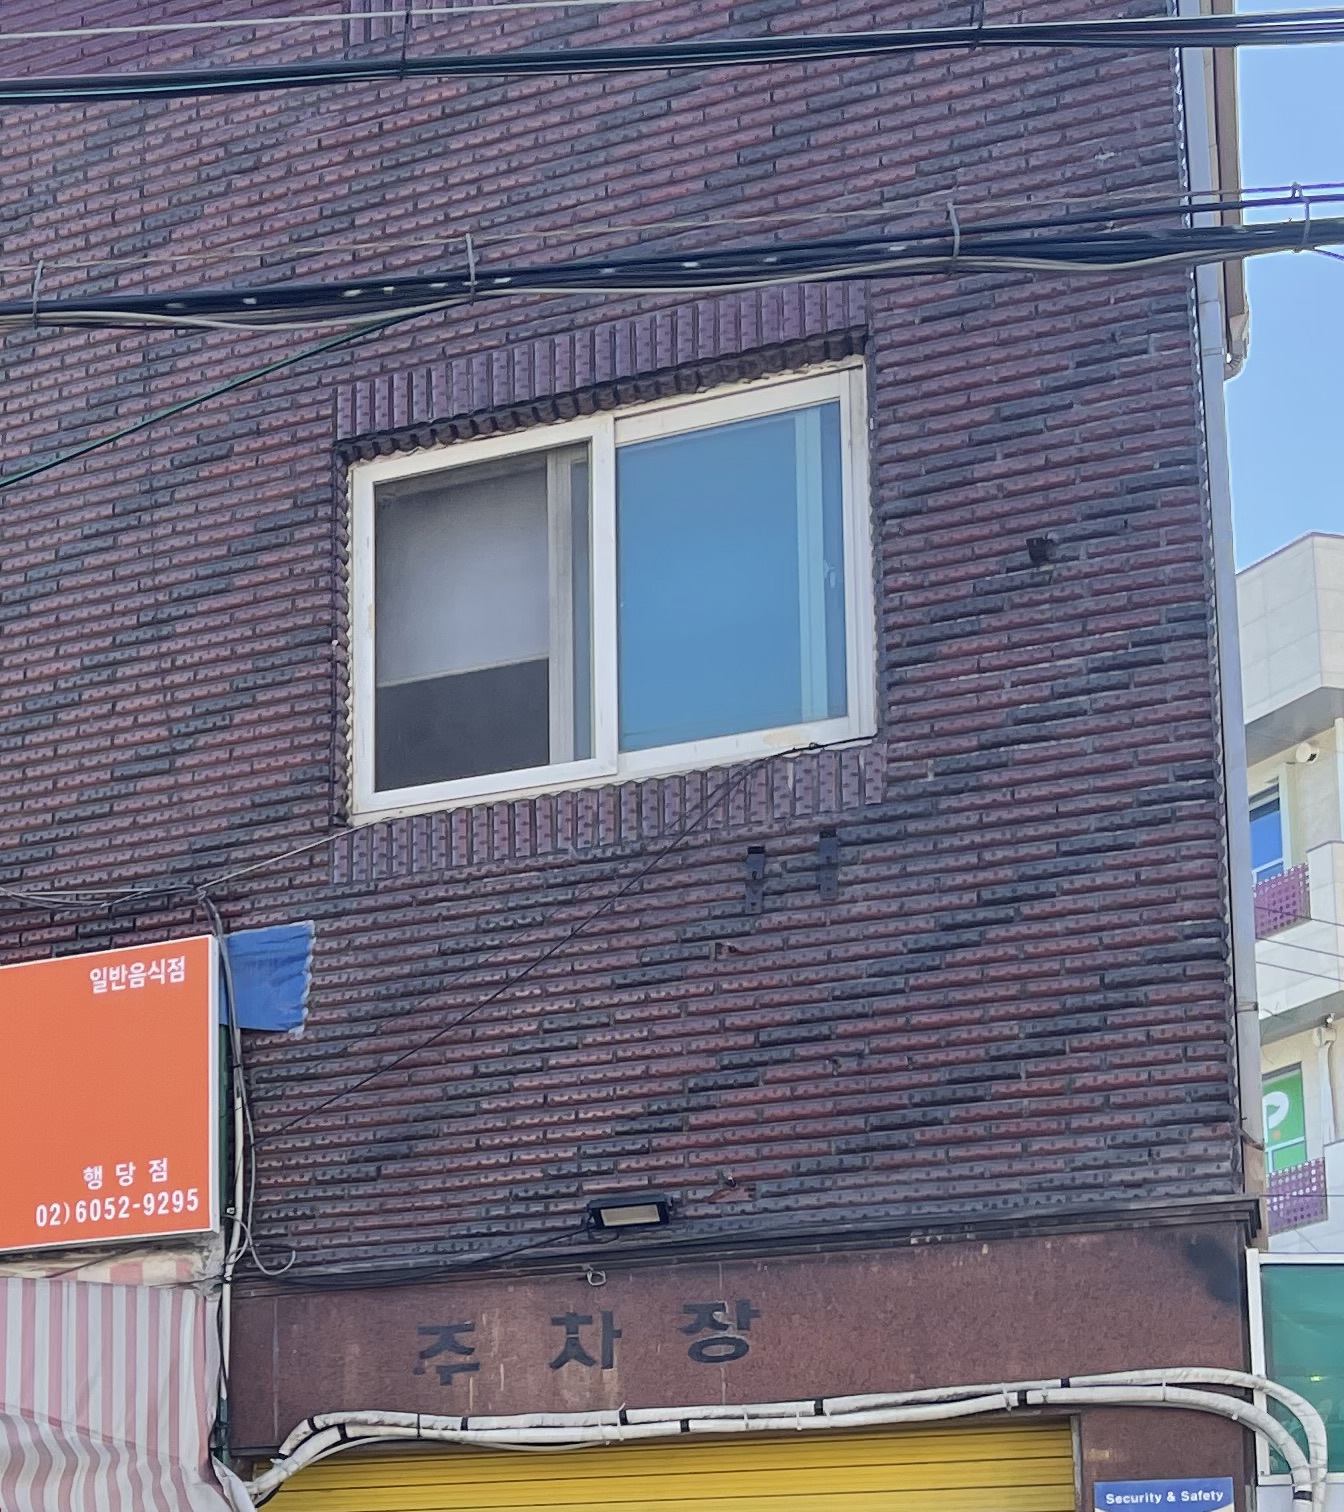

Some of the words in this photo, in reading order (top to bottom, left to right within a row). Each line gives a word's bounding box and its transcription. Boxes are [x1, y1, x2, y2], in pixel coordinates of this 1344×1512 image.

[89, 955, 186, 994] 일반음식점
[83, 1157, 169, 1191] 행당점
[35, 1188, 200, 1228] 02)6052-9295
[1106, 1491, 1162, 1505] Security
[1166, 1491, 1176, 1502] &
[1181, 1489, 1224, 1502] Safety
